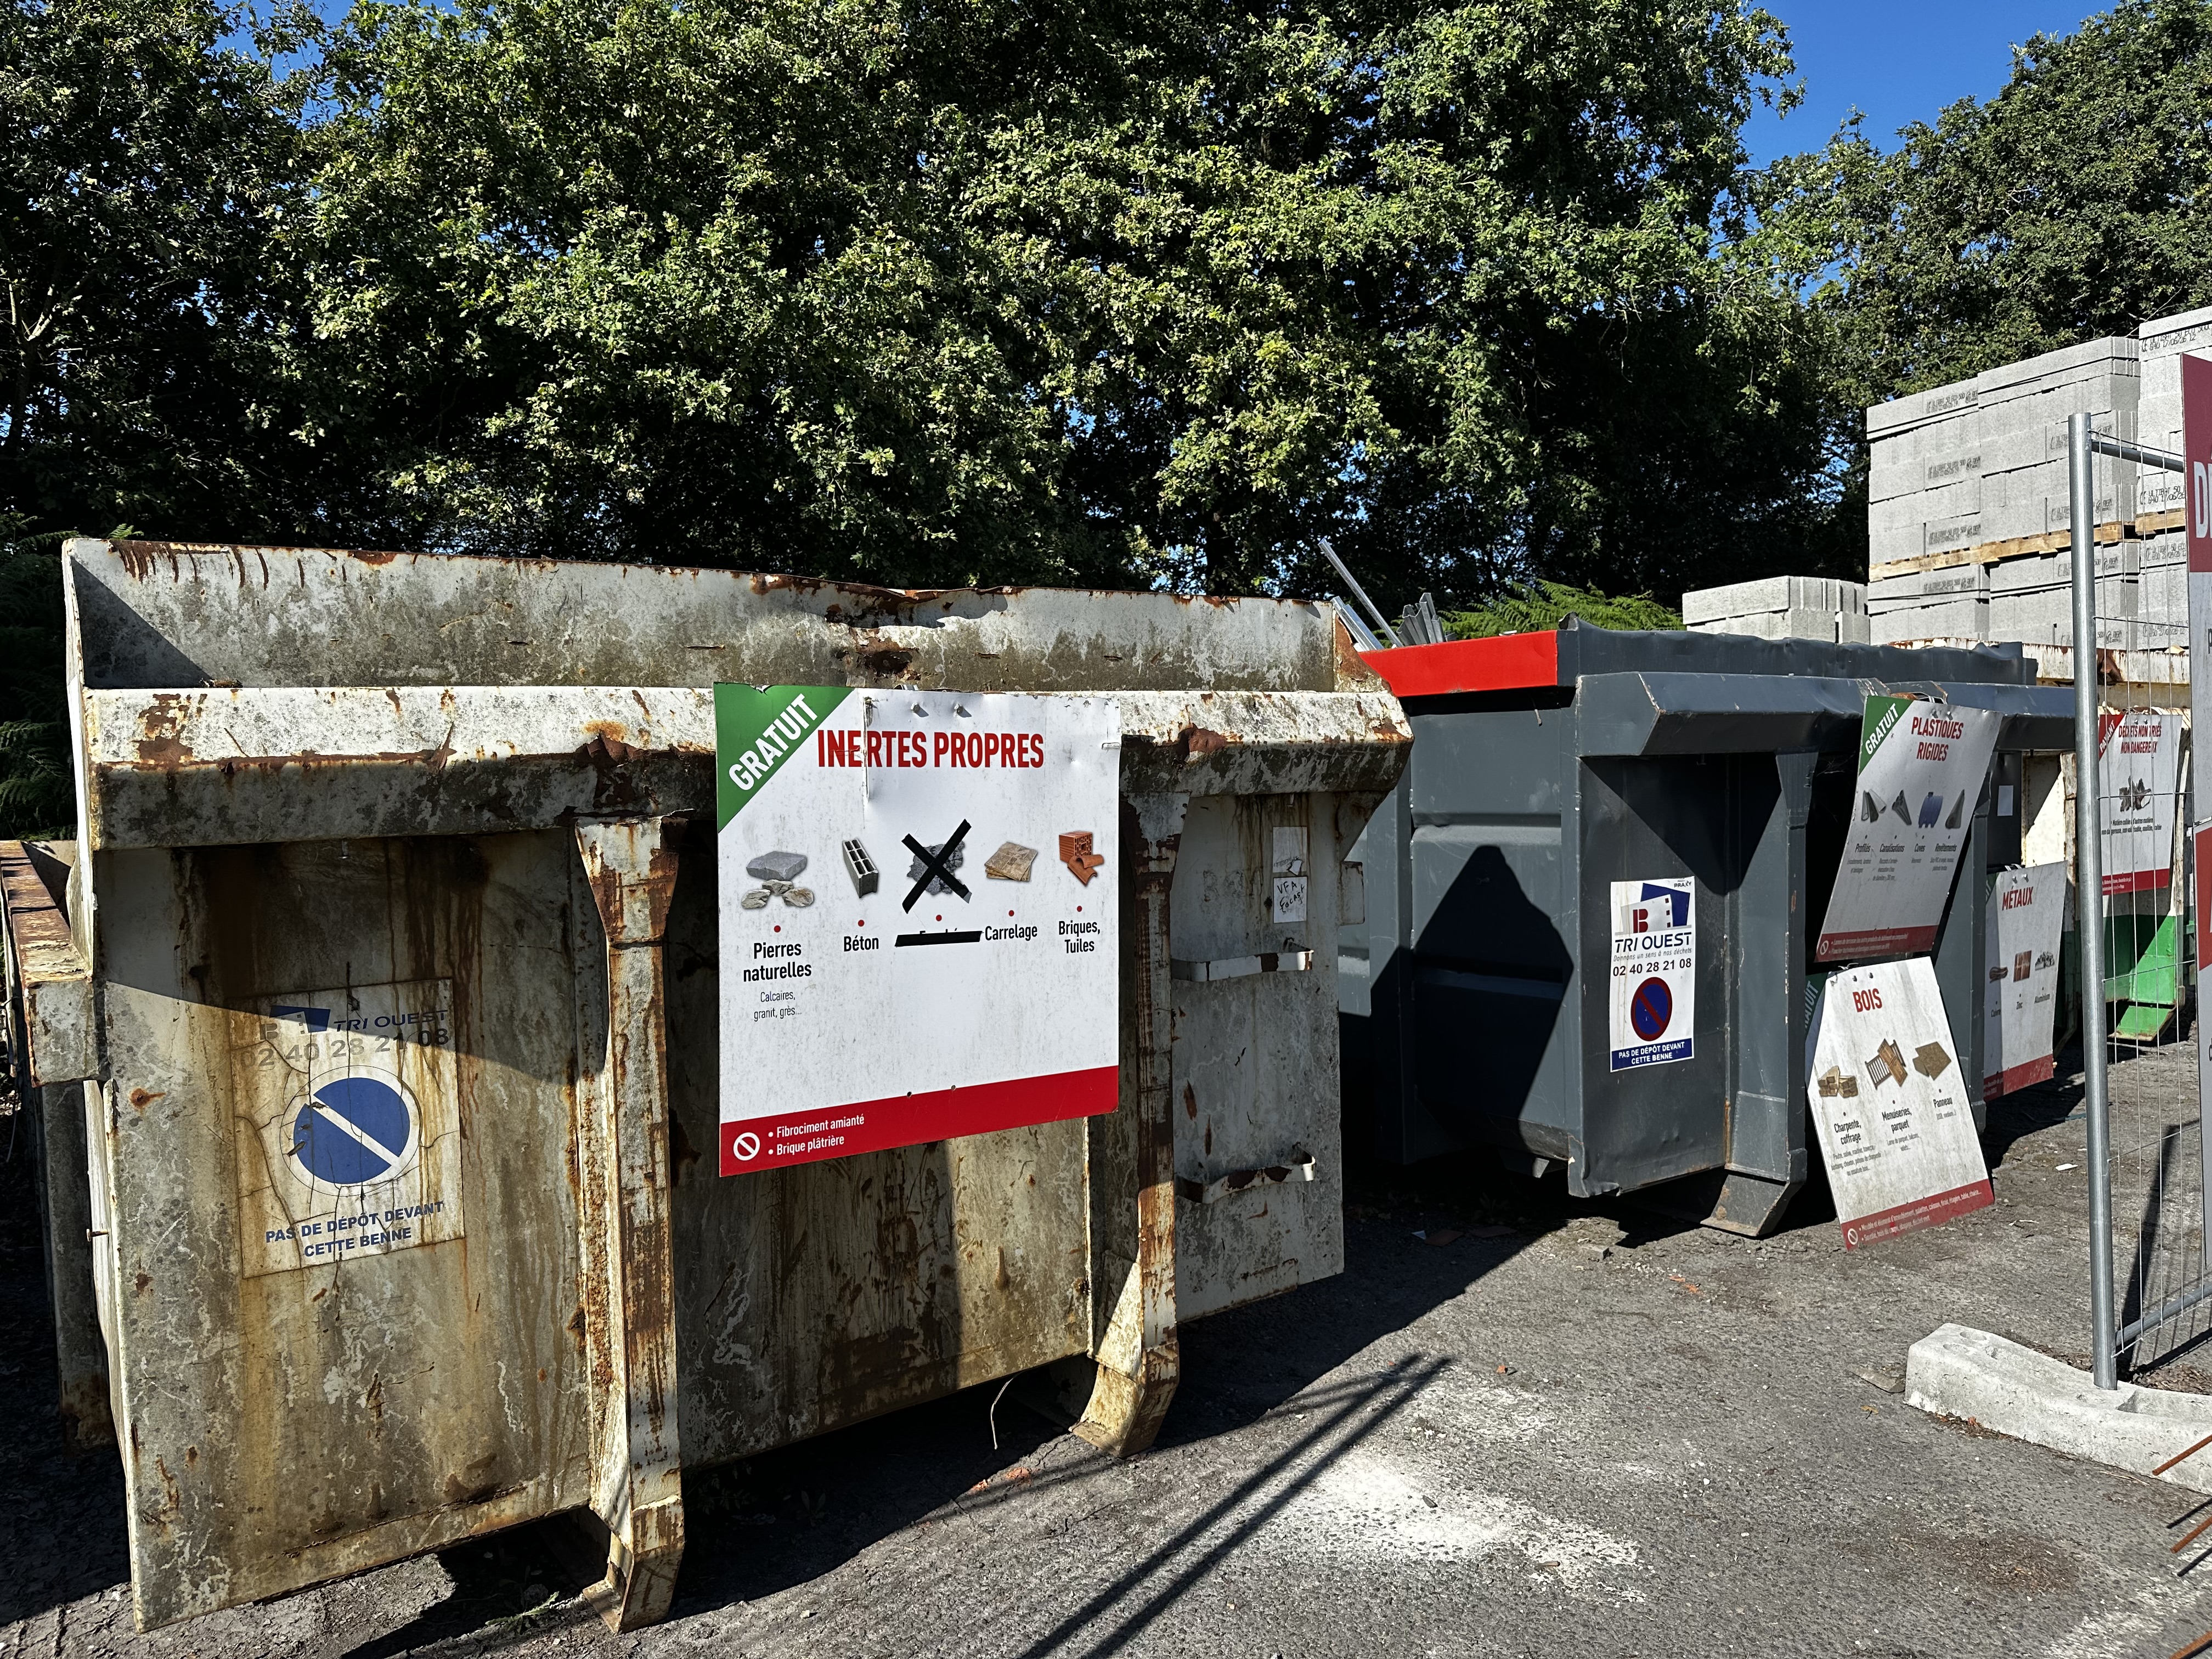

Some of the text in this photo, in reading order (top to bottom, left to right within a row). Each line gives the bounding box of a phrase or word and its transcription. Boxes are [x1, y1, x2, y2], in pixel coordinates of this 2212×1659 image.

[2194, 461, 2212, 538] D
[1865, 703, 1898, 755] GRATUIT
[1911, 716, 1963, 740] PLASTIQUES
[2139, 725, 2148, 737] NON
[729, 693, 818, 791] GRATUIT
[818, 730, 1043, 769] INERTES PROPRES
[1916, 742, 1949, 761] RIGIDES
[1277, 881, 1297, 894] VFA
[2002, 885, 2033, 911] MÉTAUX
[985, 924, 1037, 941] Carrelage
[1058, 920, 1100, 937] Briques,
[753, 942, 802, 959] Pierres
[844, 935, 879, 952] Béton
[1065, 939, 1094, 953] Tuiles
[1615, 932, 1691, 953] TRI OUEST
[743, 962, 812, 982] naturelles
[1613, 958, 1691, 976] 02 40 28 21 08
[760, 991, 795, 1002] Calcaires,
[1852, 988, 1883, 1013] BOIS
[334, 1009, 448, 1032] TRI OUEST
[754, 1007, 777, 1022] granit,
[285, 1042, 320, 1062] 40
[331, 1038, 364, 1058] 28
[375, 1033, 404, 1053] 21
[418, 1028, 449, 1047] 08
[1641, 1045, 1661, 1055] DÉPÔT
[1662, 1042, 1685, 1051] DEVANT
[1632, 1052, 1672, 1064] CETTE BENNE
[1882, 1107, 1912, 1121] Menuiseries,
[777, 1114, 864, 1138] Fibrociment amianté
[1834, 1120, 1861, 1133] Charpente,
[1891, 1119, 1909, 1134] parquet
[777, 1136, 844, 1155] Brique plâtrière
[1841, 1133, 1861, 1144] coffrage
[266, 1201, 444, 1243] PAS DE DÉPÔT DEVANT
[304, 1227, 412, 1257] CETTE BENNE
